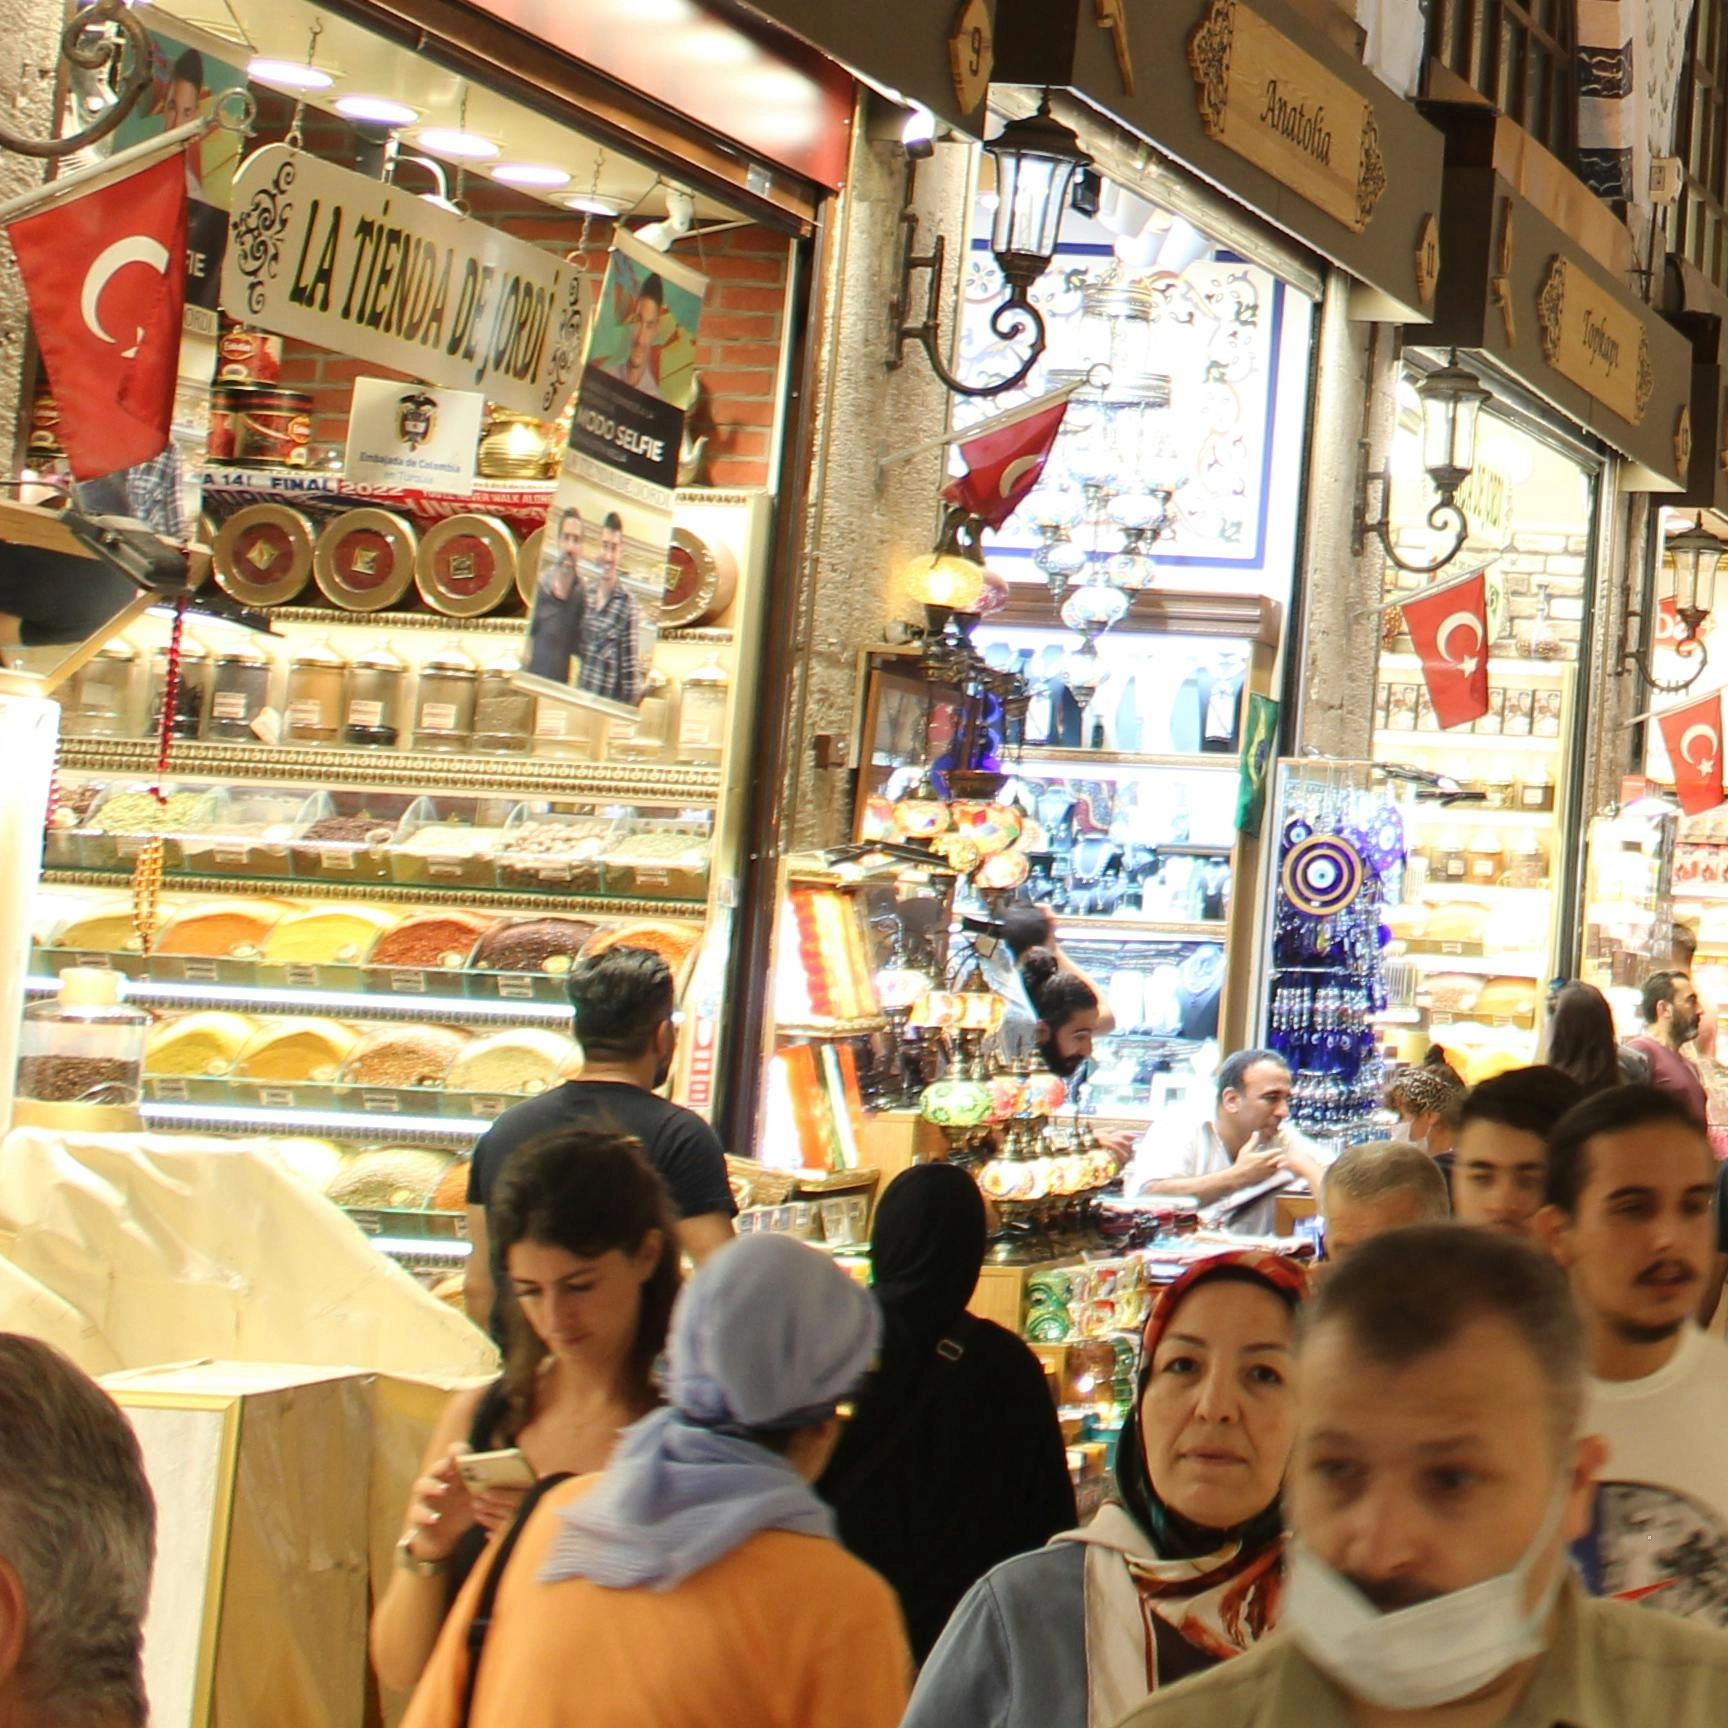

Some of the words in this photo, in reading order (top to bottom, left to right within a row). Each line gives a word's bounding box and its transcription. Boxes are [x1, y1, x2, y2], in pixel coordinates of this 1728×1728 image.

[968, 26, 983, 77] 9
[1259, 78, 1333, 166] Anatolia
[289, 199, 342, 312] LA
[446, 257, 500, 362] DE
[615, 424, 666, 464] SELFIE
[270, 477, 332, 491] FINAL
[340, 482, 404, 496] 2022
